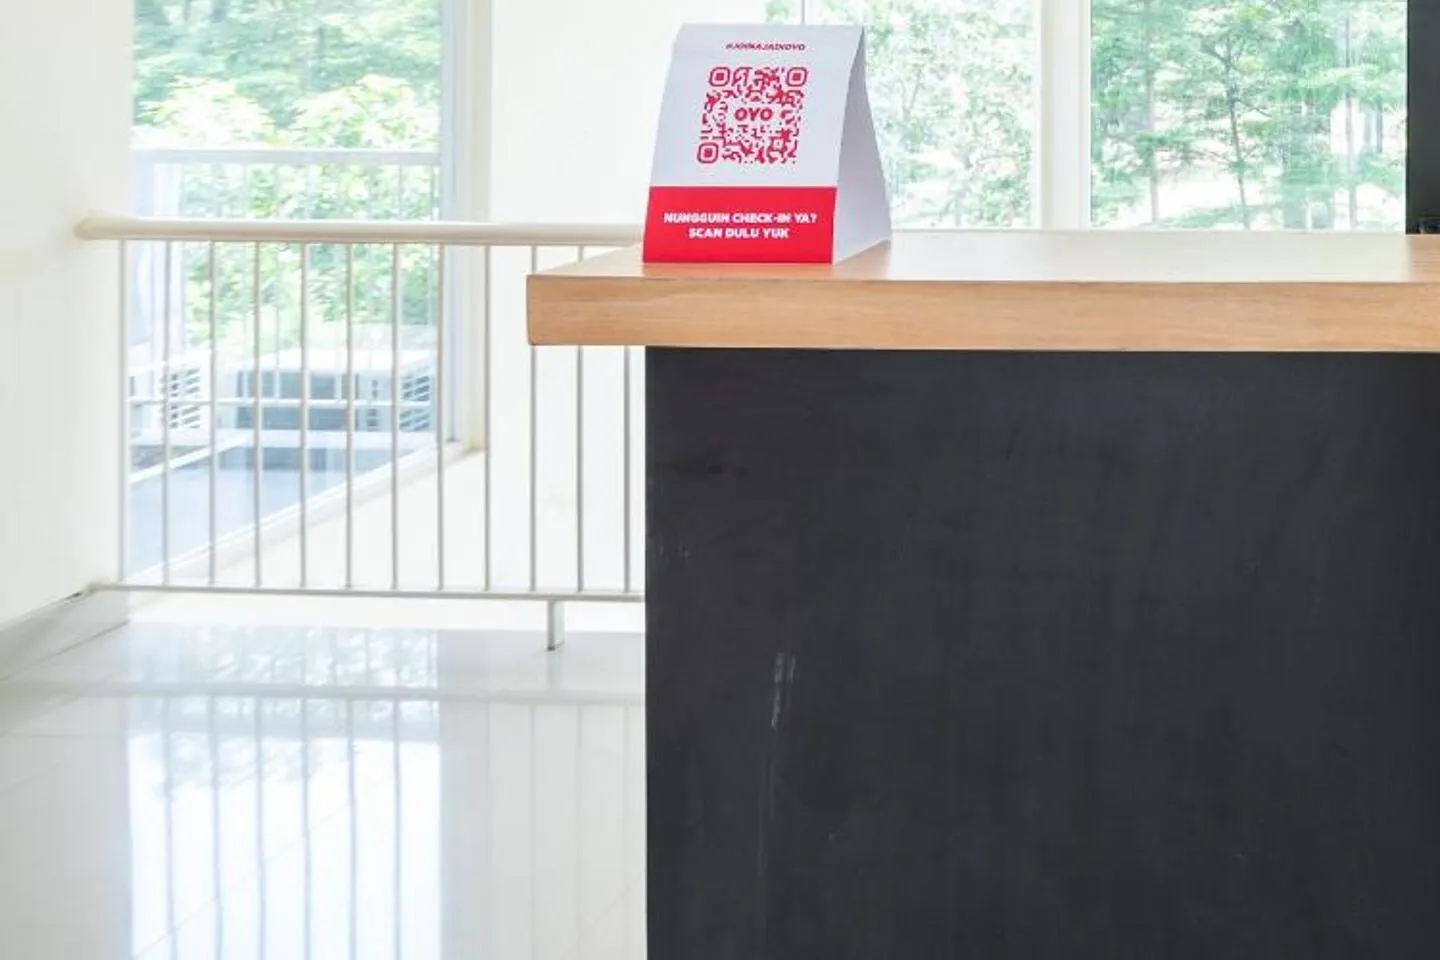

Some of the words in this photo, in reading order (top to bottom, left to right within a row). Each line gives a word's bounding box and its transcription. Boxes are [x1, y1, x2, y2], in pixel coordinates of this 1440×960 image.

[734, 107, 773, 121] OYO
[663, 212, 730, 224] NUNGGUIN
[732, 212, 792, 224] CHECK-IN
[794, 212, 818, 224] YA?
[688, 227, 723, 239] SCAN
[725, 227, 760, 239] DULU
[762, 227, 789, 239] YUK
